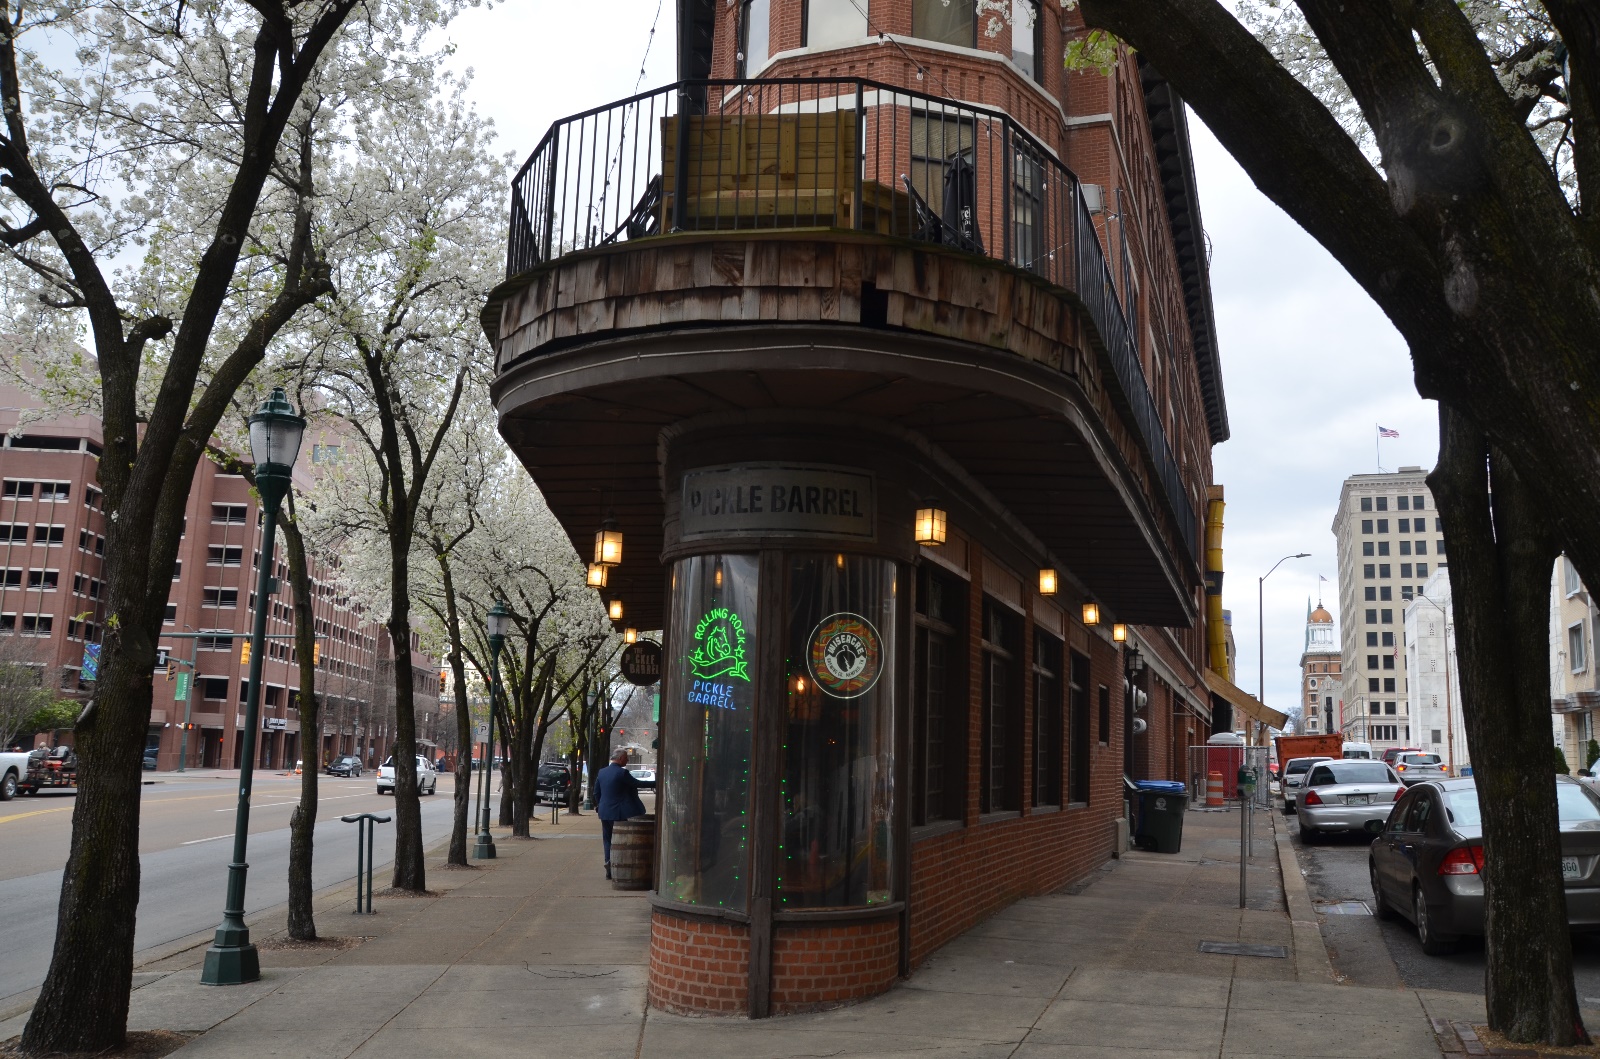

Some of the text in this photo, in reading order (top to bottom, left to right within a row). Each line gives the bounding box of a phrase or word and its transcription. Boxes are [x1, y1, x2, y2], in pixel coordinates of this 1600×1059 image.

[690, 485, 864, 518] PICKLE BARREL
[695, 608, 746, 644] ROLLING ROCK
[828, 635, 864, 655] WISEACRE
[694, 680, 733, 697] PICKLE
[688, 692, 737, 710] BARRELL
